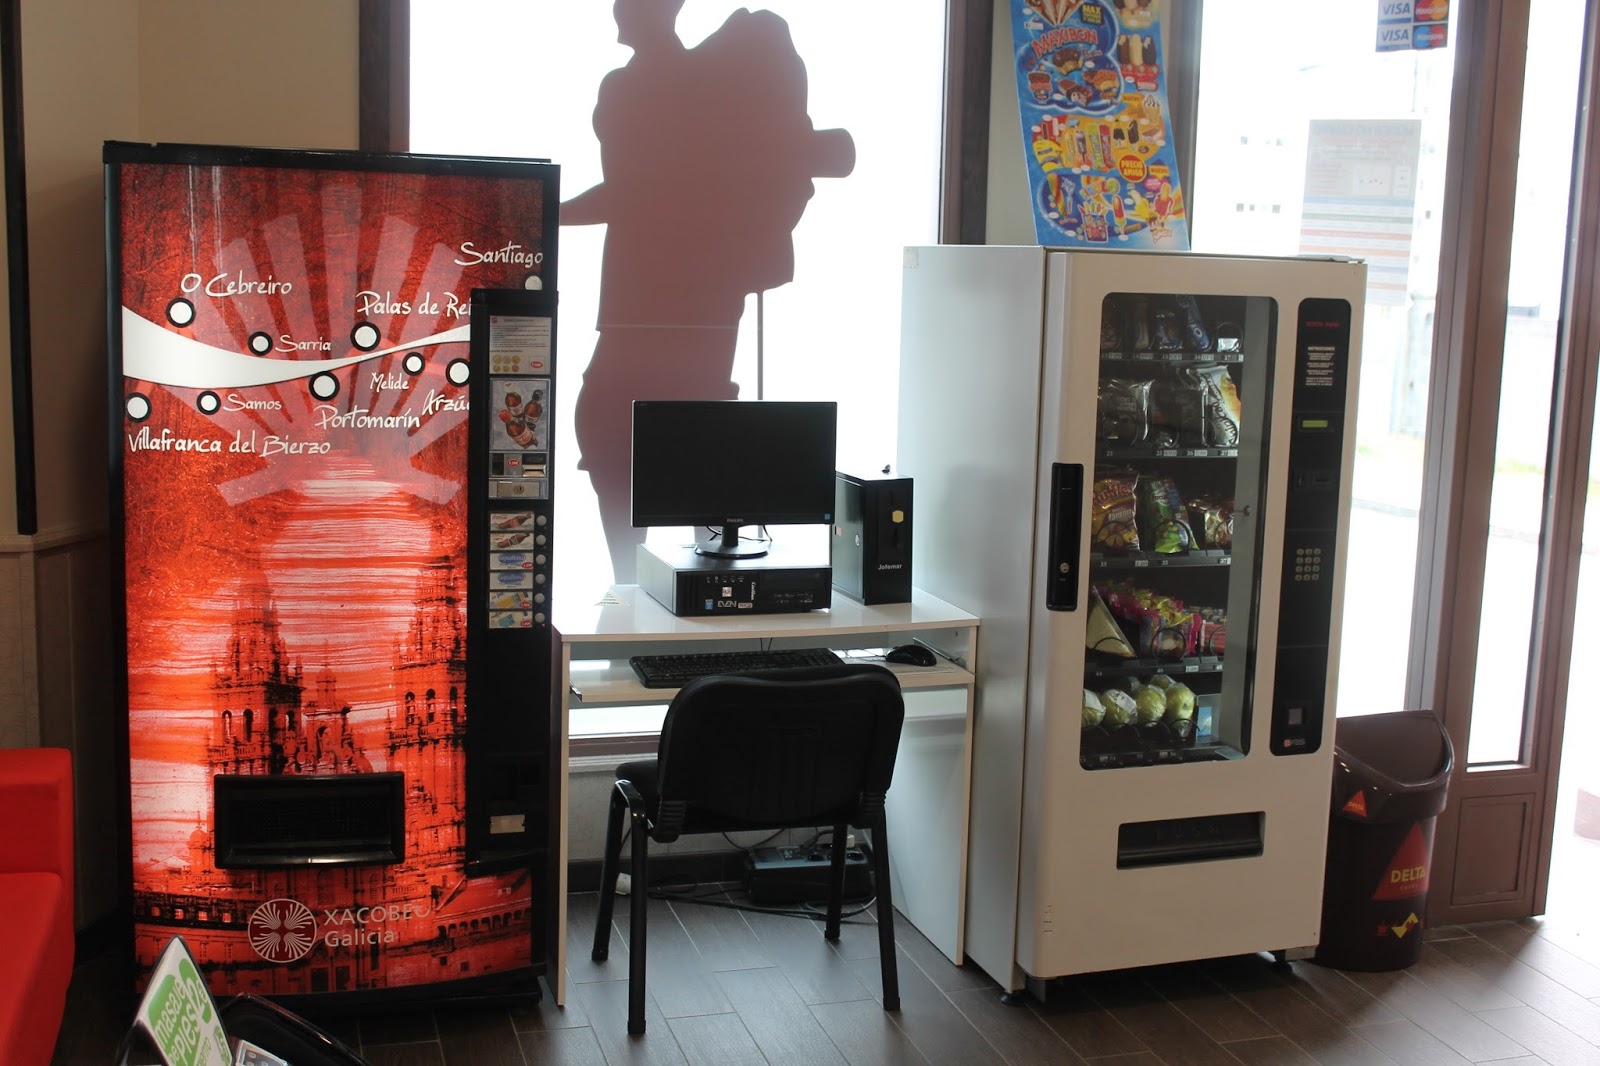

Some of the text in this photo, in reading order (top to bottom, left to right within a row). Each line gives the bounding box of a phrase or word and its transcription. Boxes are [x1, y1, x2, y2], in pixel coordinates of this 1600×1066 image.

[1383, 3, 1411, 15] VISA
[1031, 26, 1098, 59] MAXIBON
[1381, 29, 1409, 41] VISA
[454, 241, 543, 268] Santiago
[181, 270, 293, 297] O Cebreiro
[356, 291, 412, 317] Palas
[418, 292, 440, 315] de
[275, 334, 332, 352] Sarria
[369, 372, 410, 393] Melide
[223, 393, 283, 412] Samos
[313, 404, 421, 430] Portomarín
[128, 426, 331, 458] Villafranca del Bierzo
[1390, 866, 1426, 884] DELTA
[324, 903, 431, 926] XACOBEO
[324, 927, 395, 947] Galicia
